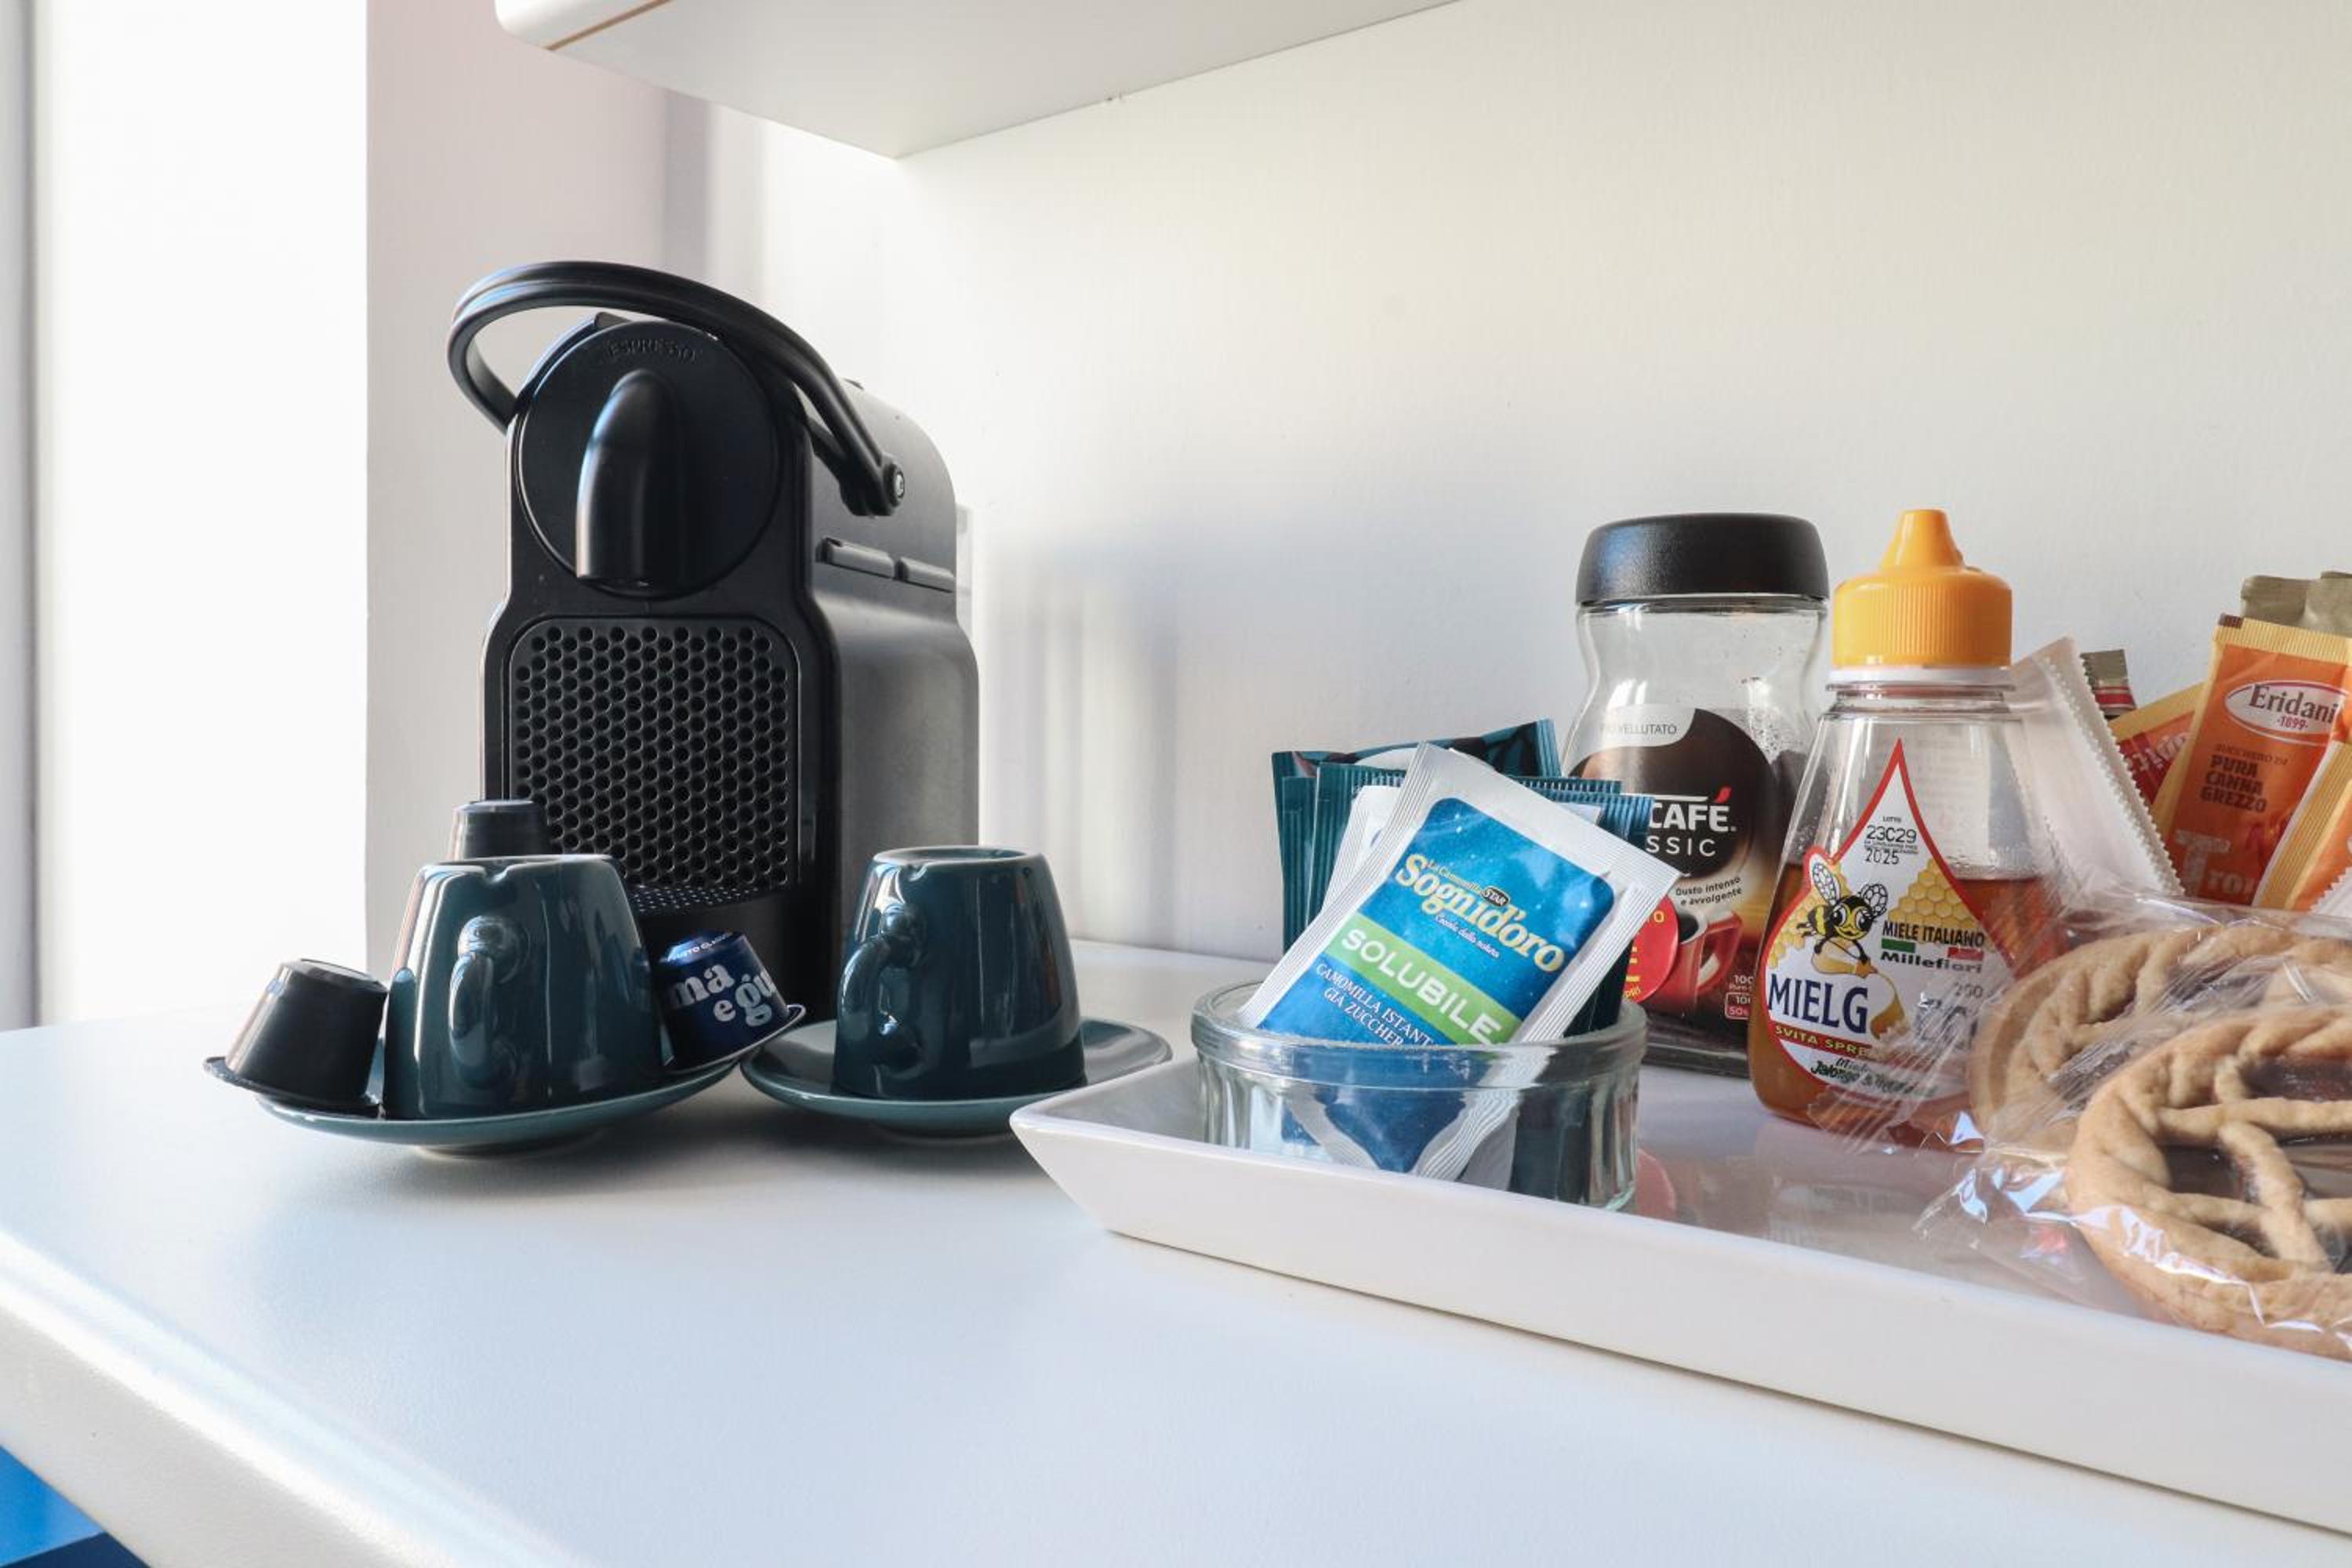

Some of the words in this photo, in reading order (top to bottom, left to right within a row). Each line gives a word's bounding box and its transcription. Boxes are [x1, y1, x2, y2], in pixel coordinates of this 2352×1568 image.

[2249, 683, 2339, 724] Eridani
[2209, 754, 2258, 778] PURA
[2205, 771, 2263, 795] CANNA
[1649, 786, 1731, 833] CAFÉ
[2200, 786, 2268, 812] GREZZO
[1644, 834, 1716, 857] SSIC
[1864, 848, 1900, 866] 2025
[1689, 887, 1743, 907] avvolgente
[1704, 876, 1741, 895] intenso
[1882, 920, 1918, 942] MIELE
[1922, 926, 1985, 948] ITALIANO
[1880, 951, 1984, 974] Millefiori
[1341, 927, 1503, 1046] SOLUBILE
[1316, 962, 1381, 1013] CAMOMILLA
[1381, 1007, 1435, 1047] ISTANT
